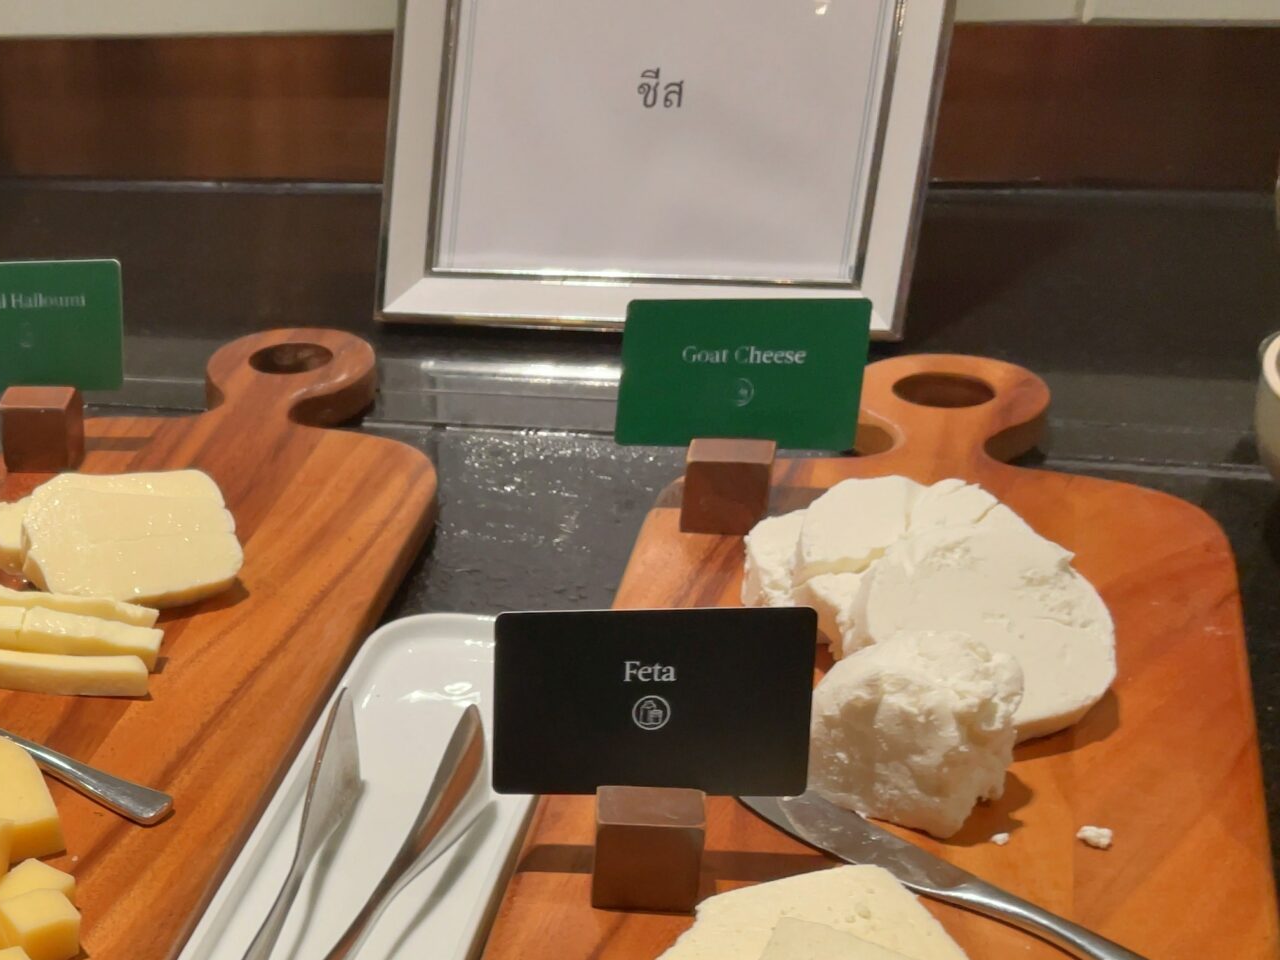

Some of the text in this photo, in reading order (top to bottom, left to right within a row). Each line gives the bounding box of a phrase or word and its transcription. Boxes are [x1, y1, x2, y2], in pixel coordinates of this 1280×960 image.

[637, 66, 685, 109] ชีส
[10, 292, 87, 309] Halloumi
[682, 345, 807, 365] Goat Cheese
[623, 660, 678, 683] Feta
